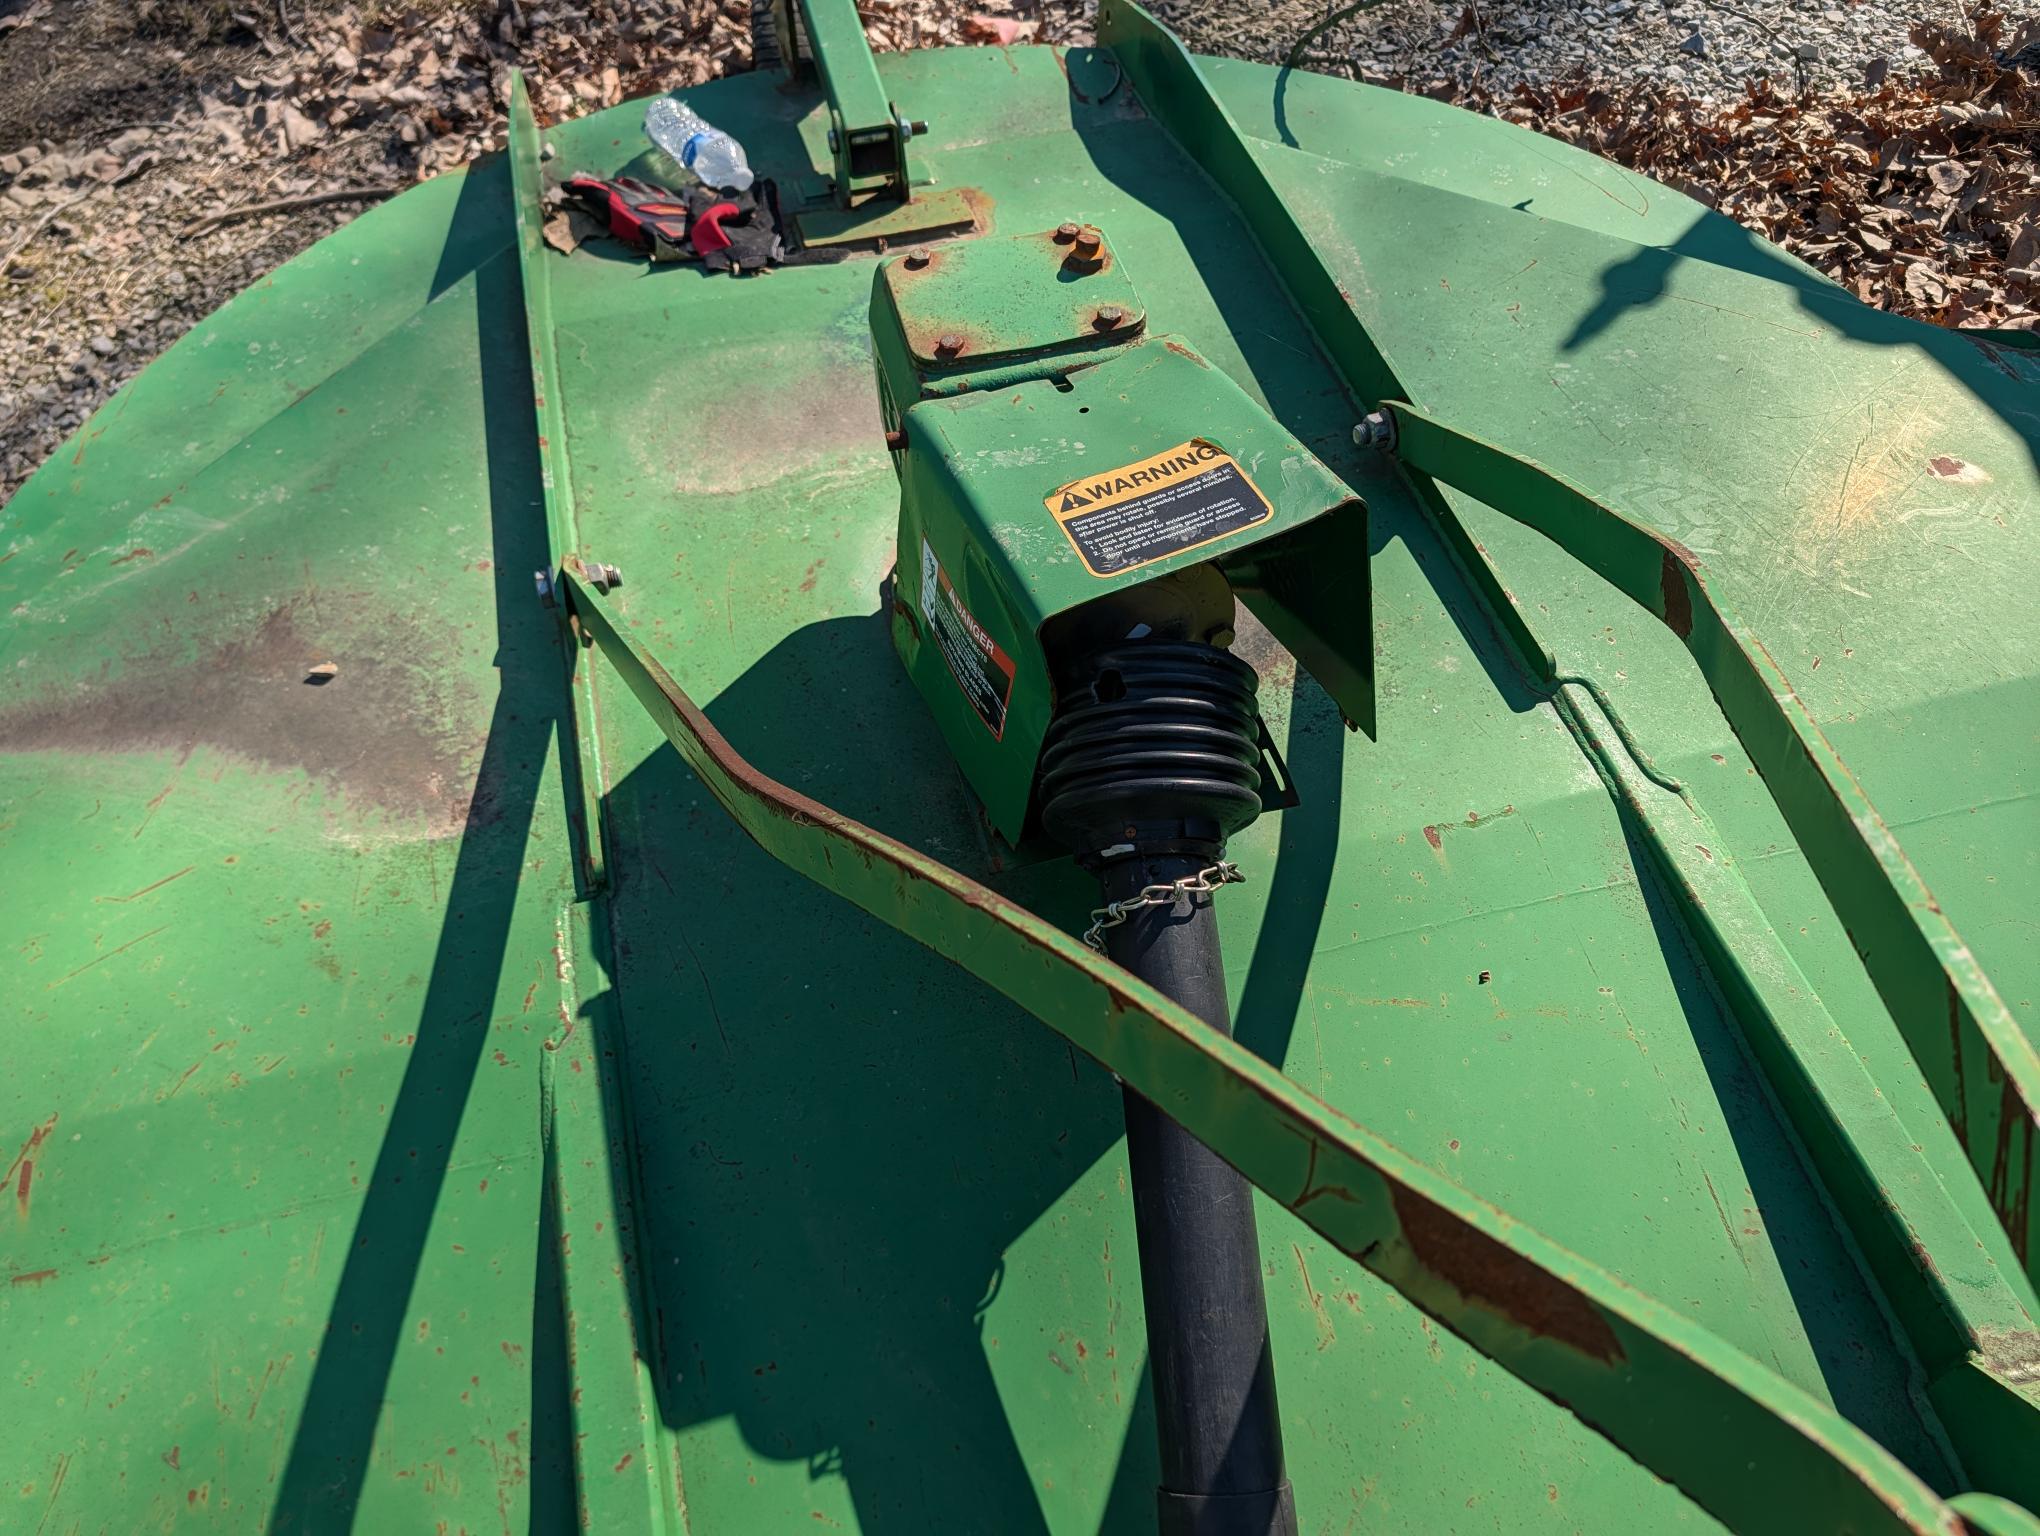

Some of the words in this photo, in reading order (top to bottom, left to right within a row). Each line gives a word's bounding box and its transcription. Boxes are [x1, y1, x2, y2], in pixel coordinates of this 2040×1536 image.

[1085, 445, 1220, 499] WARNING
[1071, 510, 1116, 527] Components
[1116, 501, 1141, 512] behind
[1142, 493, 1166, 505] guards
[1176, 481, 1201, 492] access
[1078, 529, 1095, 538] after
[1096, 522, 1118, 533] power
[1127, 513, 1144, 522] shut
[1089, 520, 1106, 528] area
[1106, 514, 1122, 522] may
[1122, 507, 1146, 517] rotate,
[1147, 496, 1176, 509] possibly
[1176, 486, 1202, 498] several
[1098, 538, 1118, 548] Look
[1118, 533, 1133, 541] and
[1132, 527, 1153, 536] listen
[1165, 512, 1197, 525] evidence
[1207, 497, 1236, 510] rotation.
[1128, 536, 1146, 545] open
[1156, 523, 1184, 535] remove
[1184, 515, 1205, 526] guard
[1215, 502, 1241, 514] access
[1094, 533, 1114, 543] avoid
[1114, 526, 1136, 536] bodily
[1137, 518, 1159, 529] injury:
[1105, 550, 1123, 559] door
[1124, 544, 1141, 553] until
[1152, 525, 1197, 543] components
[1196, 519, 1214, 528] have
[1215, 507, 1246, 521] stopped.
[956, 600, 994, 654] DANGER
